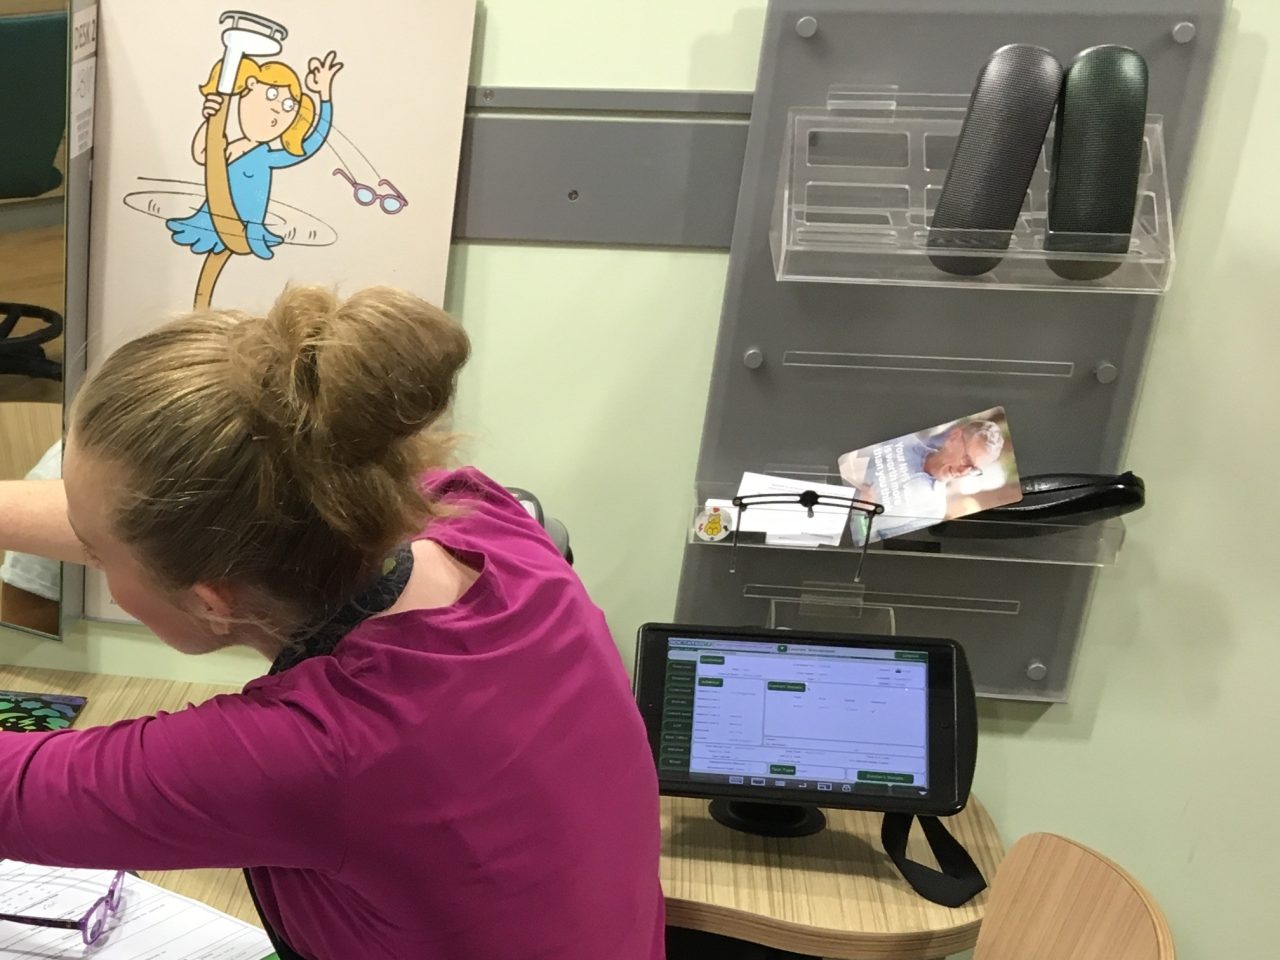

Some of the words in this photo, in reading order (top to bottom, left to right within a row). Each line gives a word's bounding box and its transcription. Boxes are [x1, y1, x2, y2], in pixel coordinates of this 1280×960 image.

[873, 447, 884, 472] than
[894, 441, 906, 462] Your
[885, 453, 897, 481] worth
[875, 471, 888, 488] you
